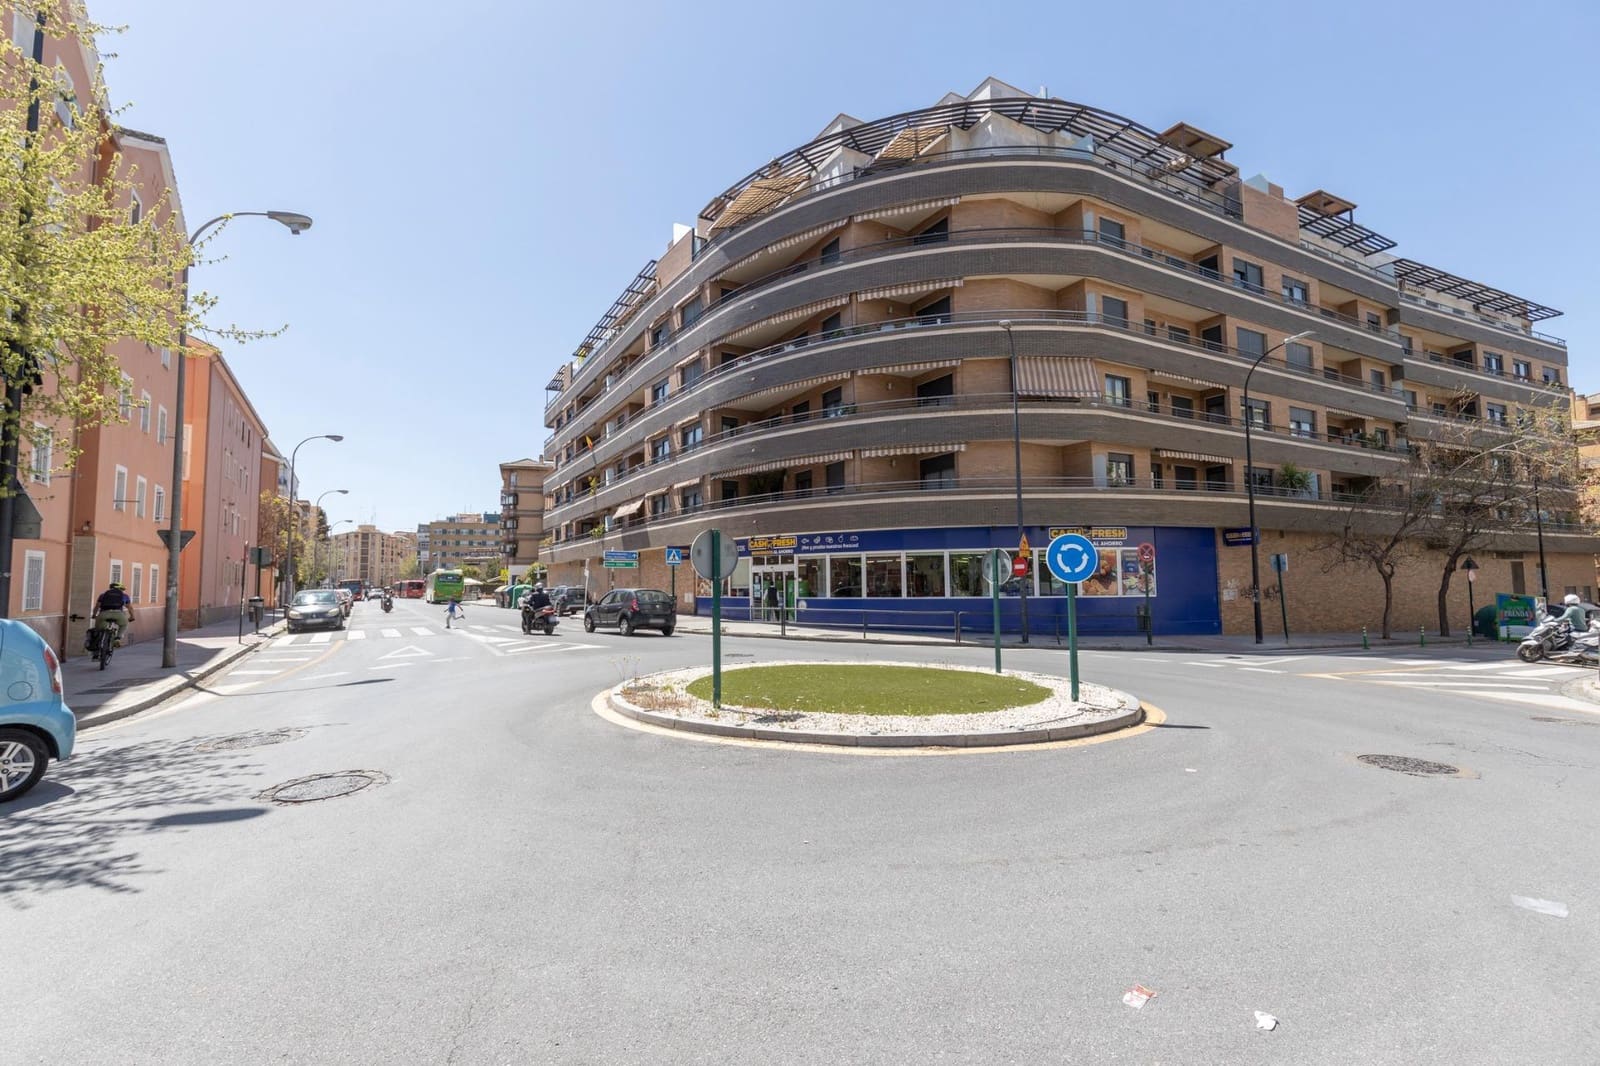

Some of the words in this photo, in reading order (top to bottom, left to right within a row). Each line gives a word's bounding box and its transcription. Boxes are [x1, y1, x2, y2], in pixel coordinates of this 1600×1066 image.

[1091, 529, 1125, 537] FRESH
[750, 540, 768, 548] CASH
[773, 538, 796, 547] FRESH
